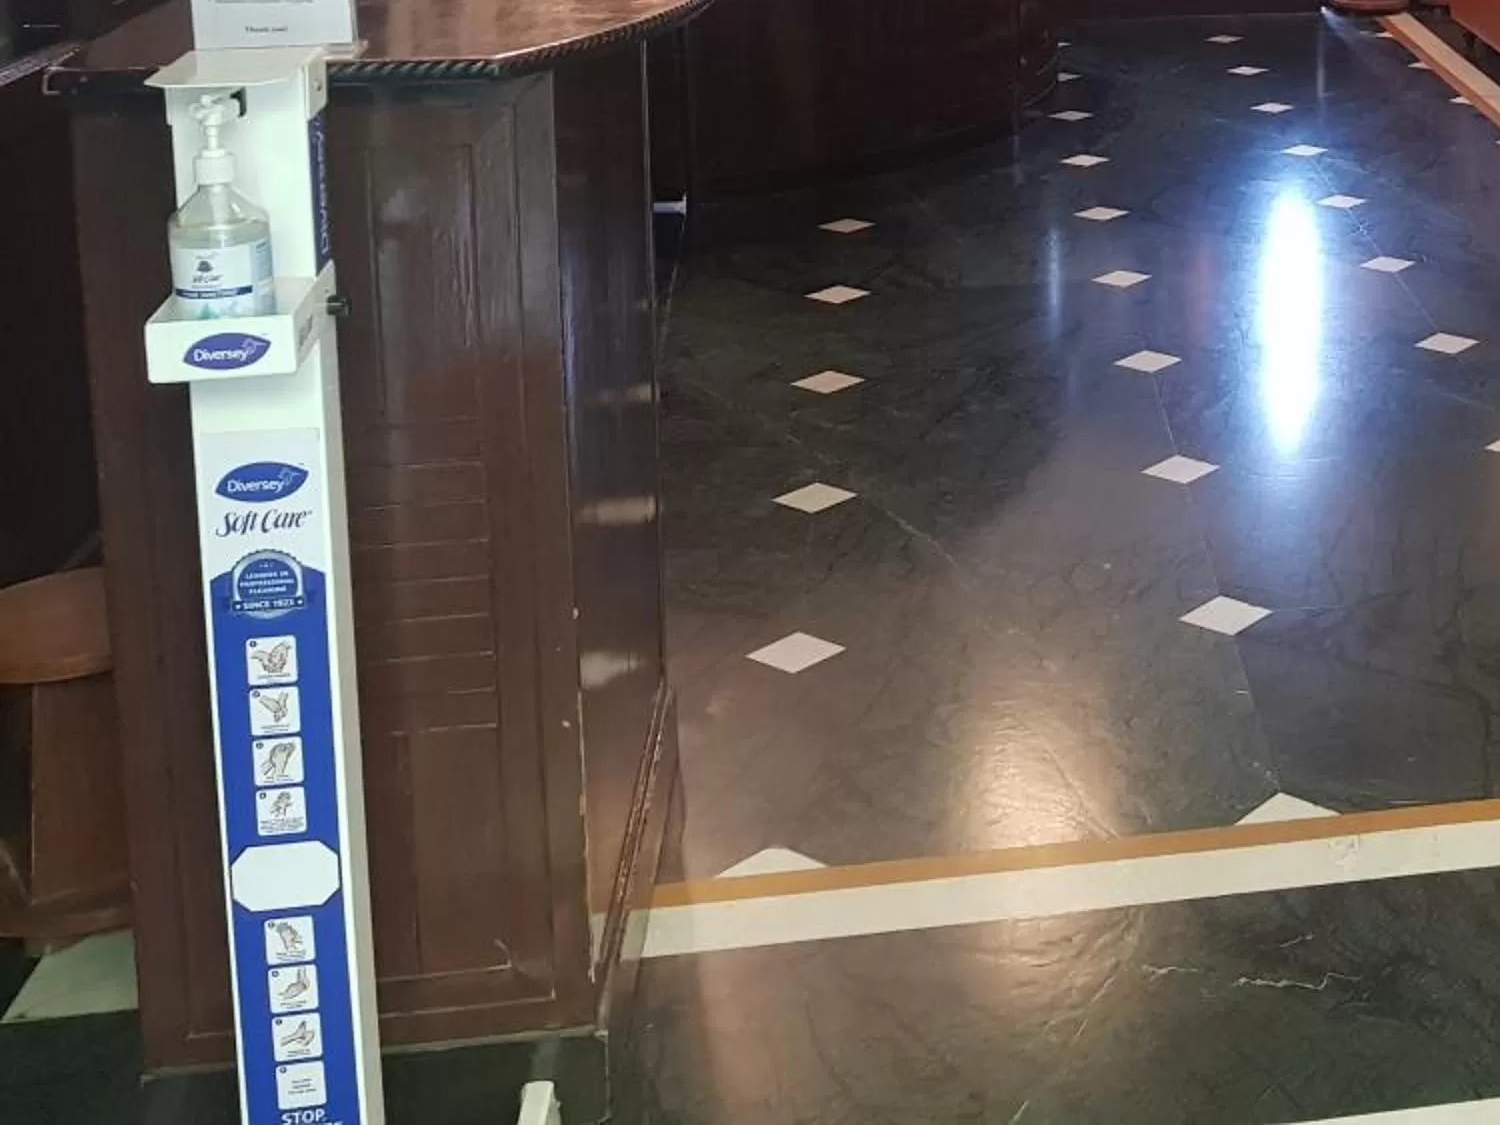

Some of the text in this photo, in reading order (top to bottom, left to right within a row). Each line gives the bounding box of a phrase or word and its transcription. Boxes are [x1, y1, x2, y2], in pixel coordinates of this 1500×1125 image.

[193, 348, 249, 362] Diversey
[227, 478, 285, 493] Diversey
[215, 509, 257, 537] Soft
